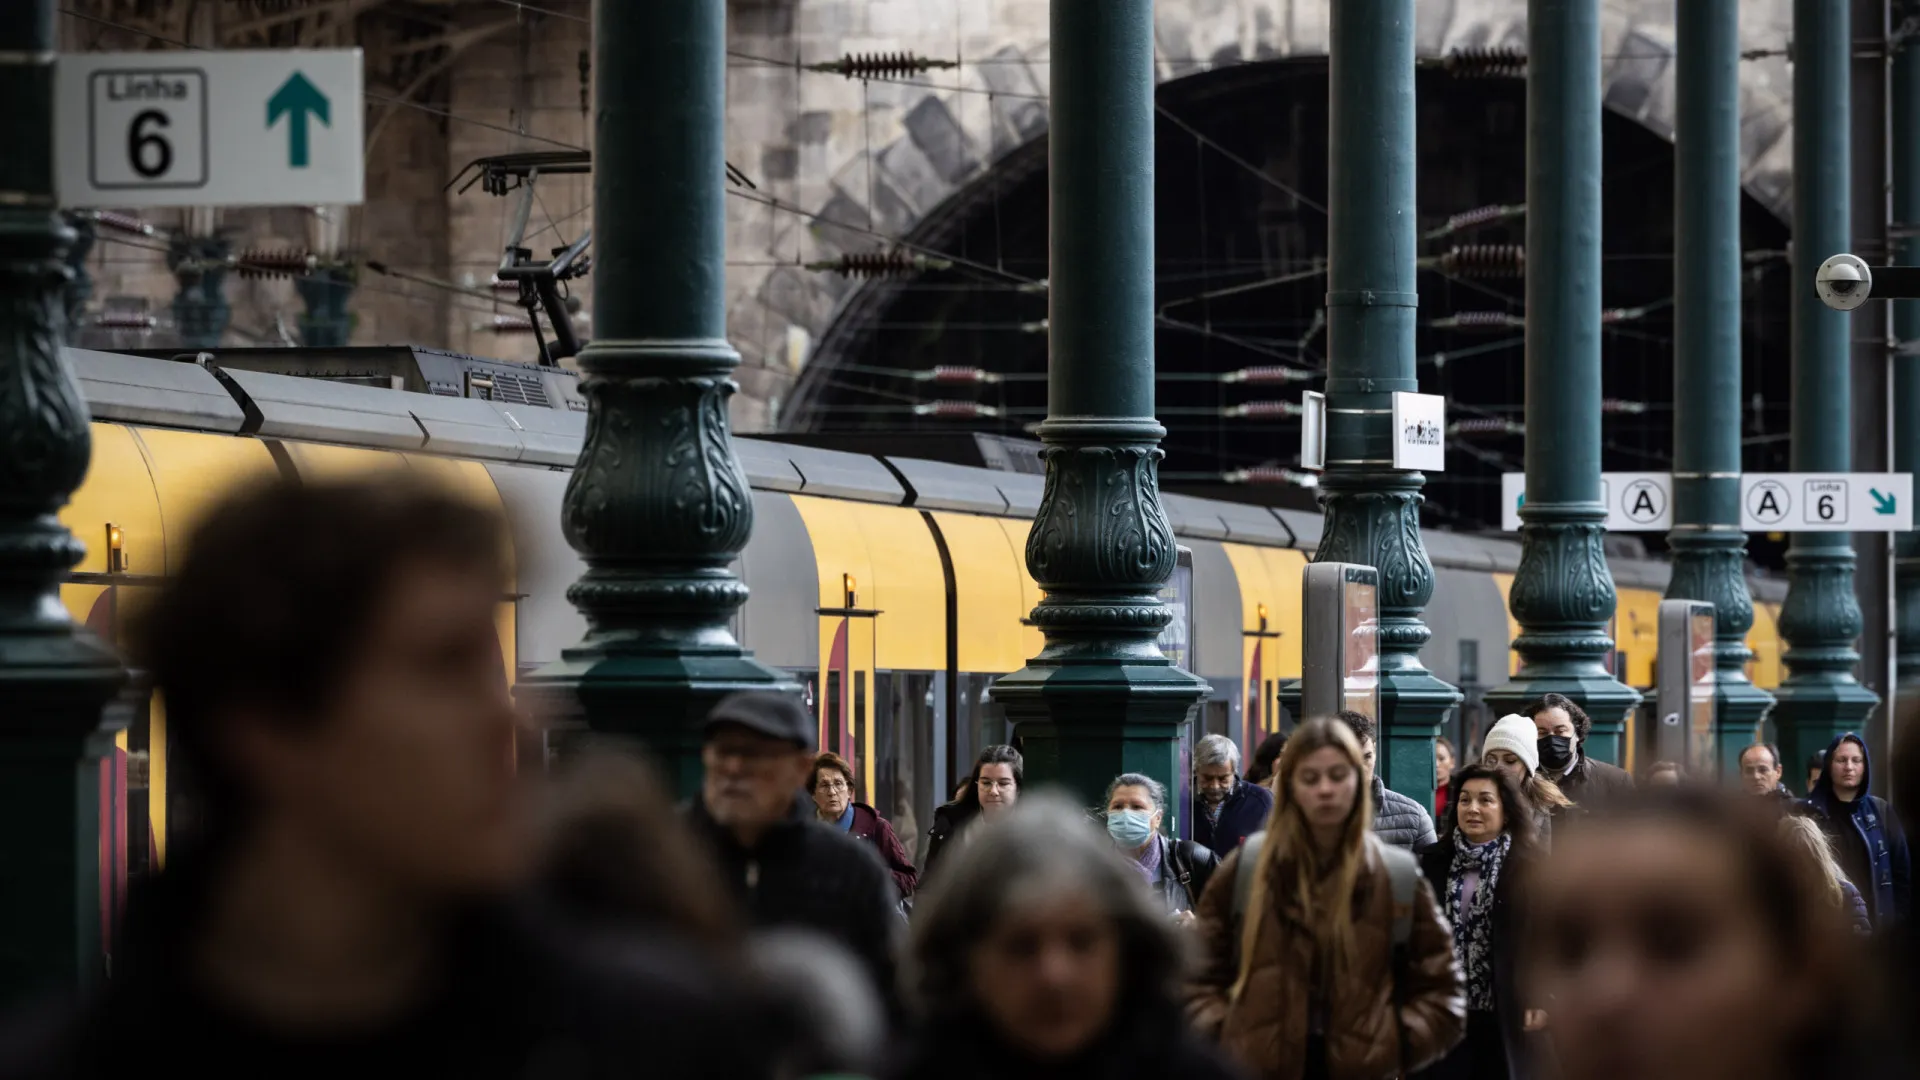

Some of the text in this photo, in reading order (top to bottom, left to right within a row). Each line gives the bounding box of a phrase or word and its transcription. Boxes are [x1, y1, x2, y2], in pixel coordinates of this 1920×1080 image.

[107, 72, 188, 101] Linha
[127, 108, 172, 178] 6
[1632, 489, 1655, 515] A
[1757, 490, 1780, 515] A
[1818, 495, 1835, 520] 6
